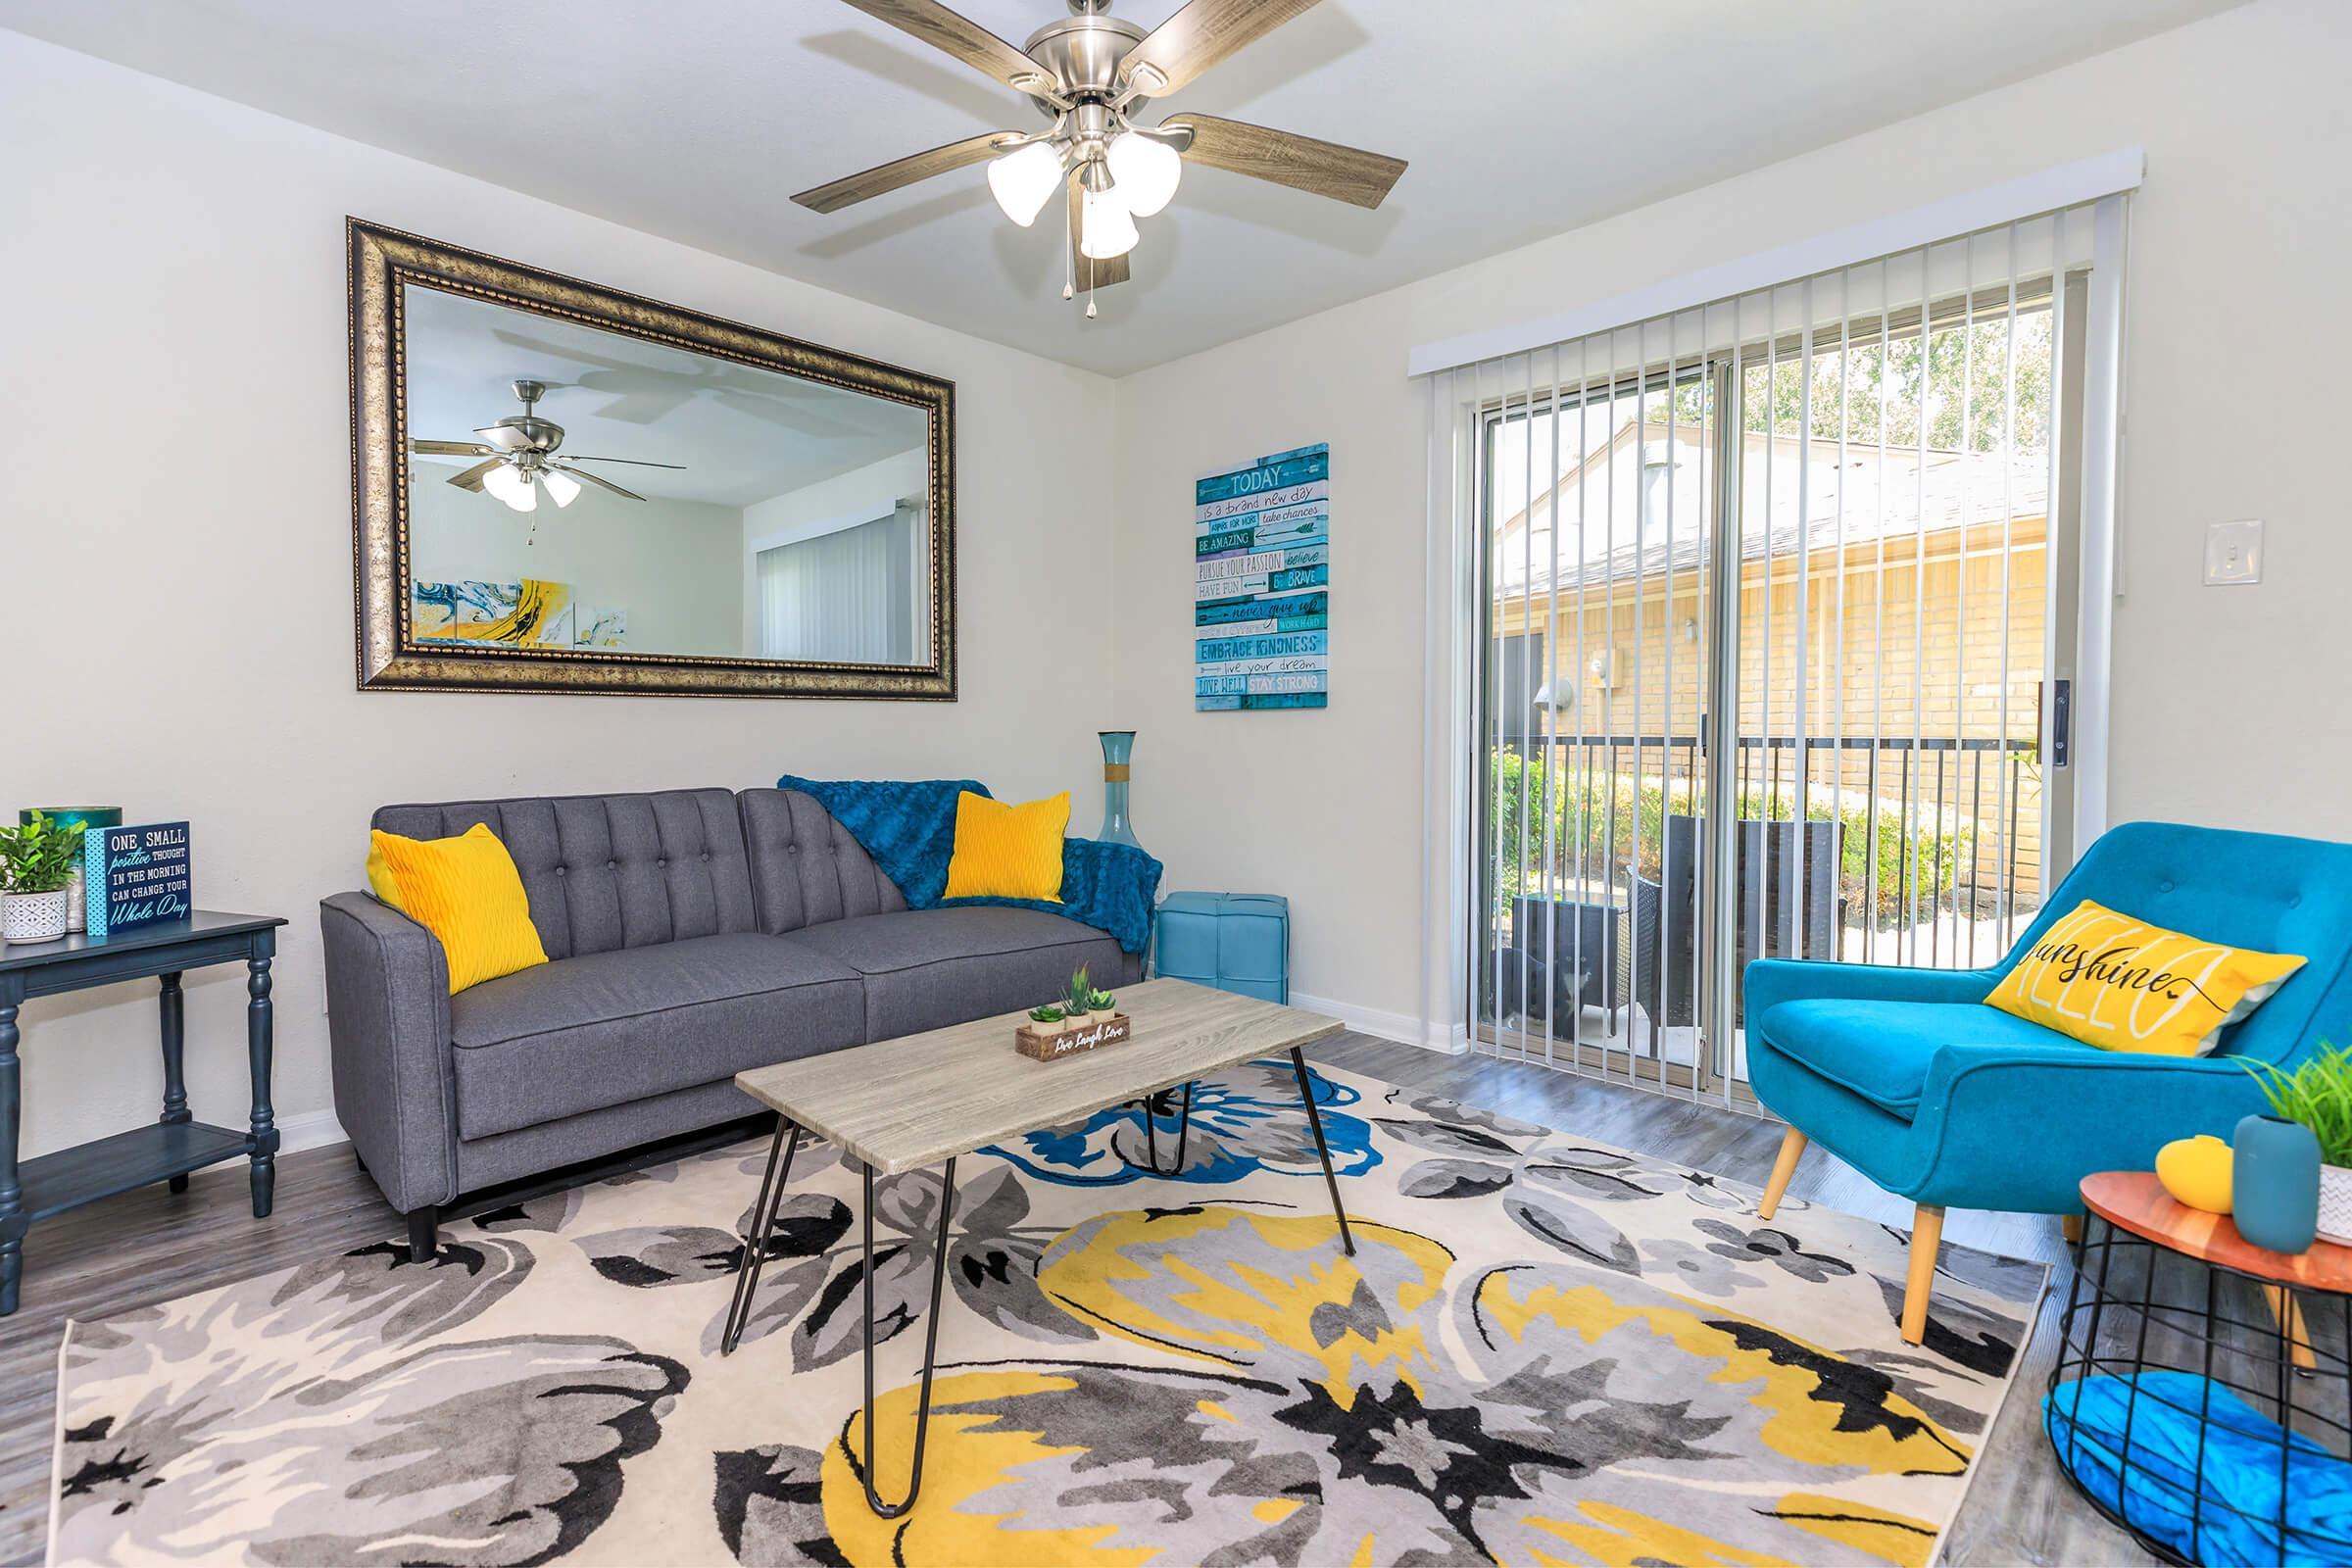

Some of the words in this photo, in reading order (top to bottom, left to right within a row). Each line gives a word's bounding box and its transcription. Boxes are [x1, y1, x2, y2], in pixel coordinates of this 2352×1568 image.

[1231, 466, 1282, 495] TODAY
[1203, 509, 1213, 520] is
[1215, 505, 1222, 515] a
[1225, 496, 1259, 515] brand
[1264, 493, 1287, 507] new
[1290, 486, 1313, 502] day
[1262, 513, 1281, 523] take
[1283, 506, 1318, 519] chances
[1199, 540, 1209, 552] BE
[1210, 532, 1249, 549] AMAZING
[1199, 562, 1224, 580] PURSUE
[1226, 558, 1245, 576] YOUR
[1247, 552, 1282, 572] PASSION
[1286, 551, 1319, 565] believe
[1199, 583, 1221, 598] HAVE
[1223, 580, 1240, 595] FUN
[1288, 570, 1316, 587] BRAVE
[1232, 606, 1263, 618] never
[1263, 603, 1294, 628] give
[1298, 599, 1318, 621] up
[1280, 619, 1299, 628] WORK
[1200, 640, 1252, 660] EMBRACE
[1255, 635, 1318, 657] KINDNESS
[1224, 662, 1241, 675] live
[1248, 662, 1274, 676] your
[1279, 659, 1316, 670] dream
[1199, 679, 1219, 695] LOVE
[1221, 677, 1244, 693] WELL
[1250, 677, 1273, 692] STAY
[1276, 675, 1318, 691] STRONG
[111, 834, 137, 852] ONE
[146, 829, 185, 848] SMALL
[108, 847, 151, 875] positive
[152, 848, 185, 861] THOUGHT
[113, 873, 125, 886] IN
[127, 870, 145, 884] THE
[147, 863, 186, 880] MORNING
[112, 889, 129, 902] CAN
[132, 883, 164, 899] CHANGE
[167, 879, 187, 893] YOUR
[110, 901, 154, 926] Whole
[157, 893, 187, 918] Day
[1054, 1037, 1073, 1054] Live
[1075, 1023, 1102, 1049] Laugh
[1104, 1025, 1124, 1040] Love
